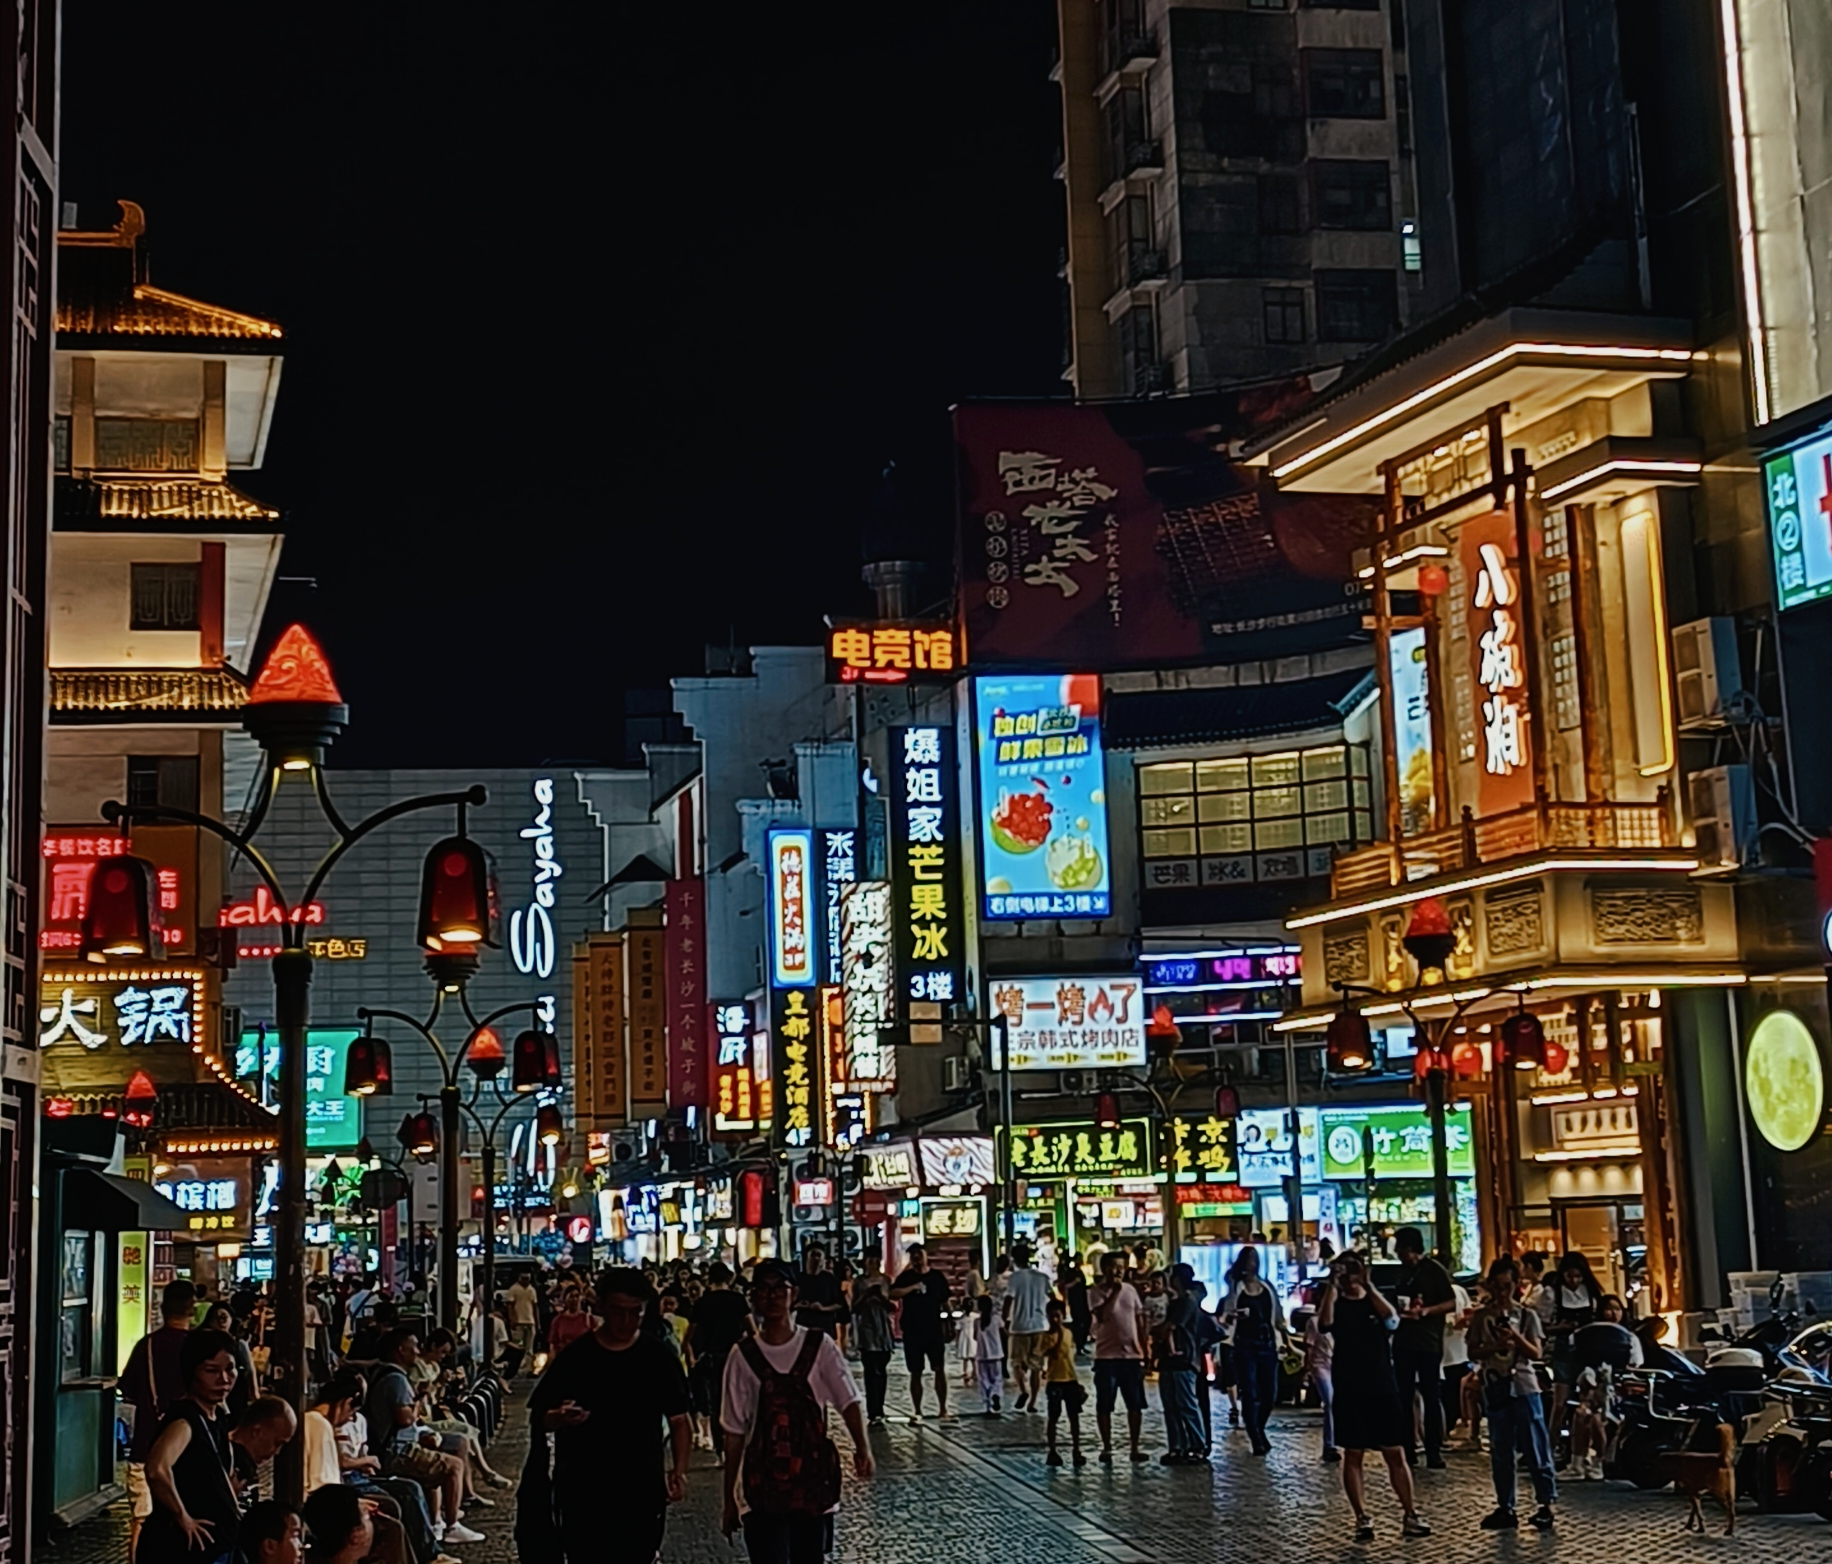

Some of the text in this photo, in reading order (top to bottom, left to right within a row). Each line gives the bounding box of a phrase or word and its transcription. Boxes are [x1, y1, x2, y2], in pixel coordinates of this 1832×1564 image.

[832, 629, 953, 670] 电竞馆
[904, 727, 950, 961] 爆姐家芒果冰
[909, 972, 954, 1001] 3楼
